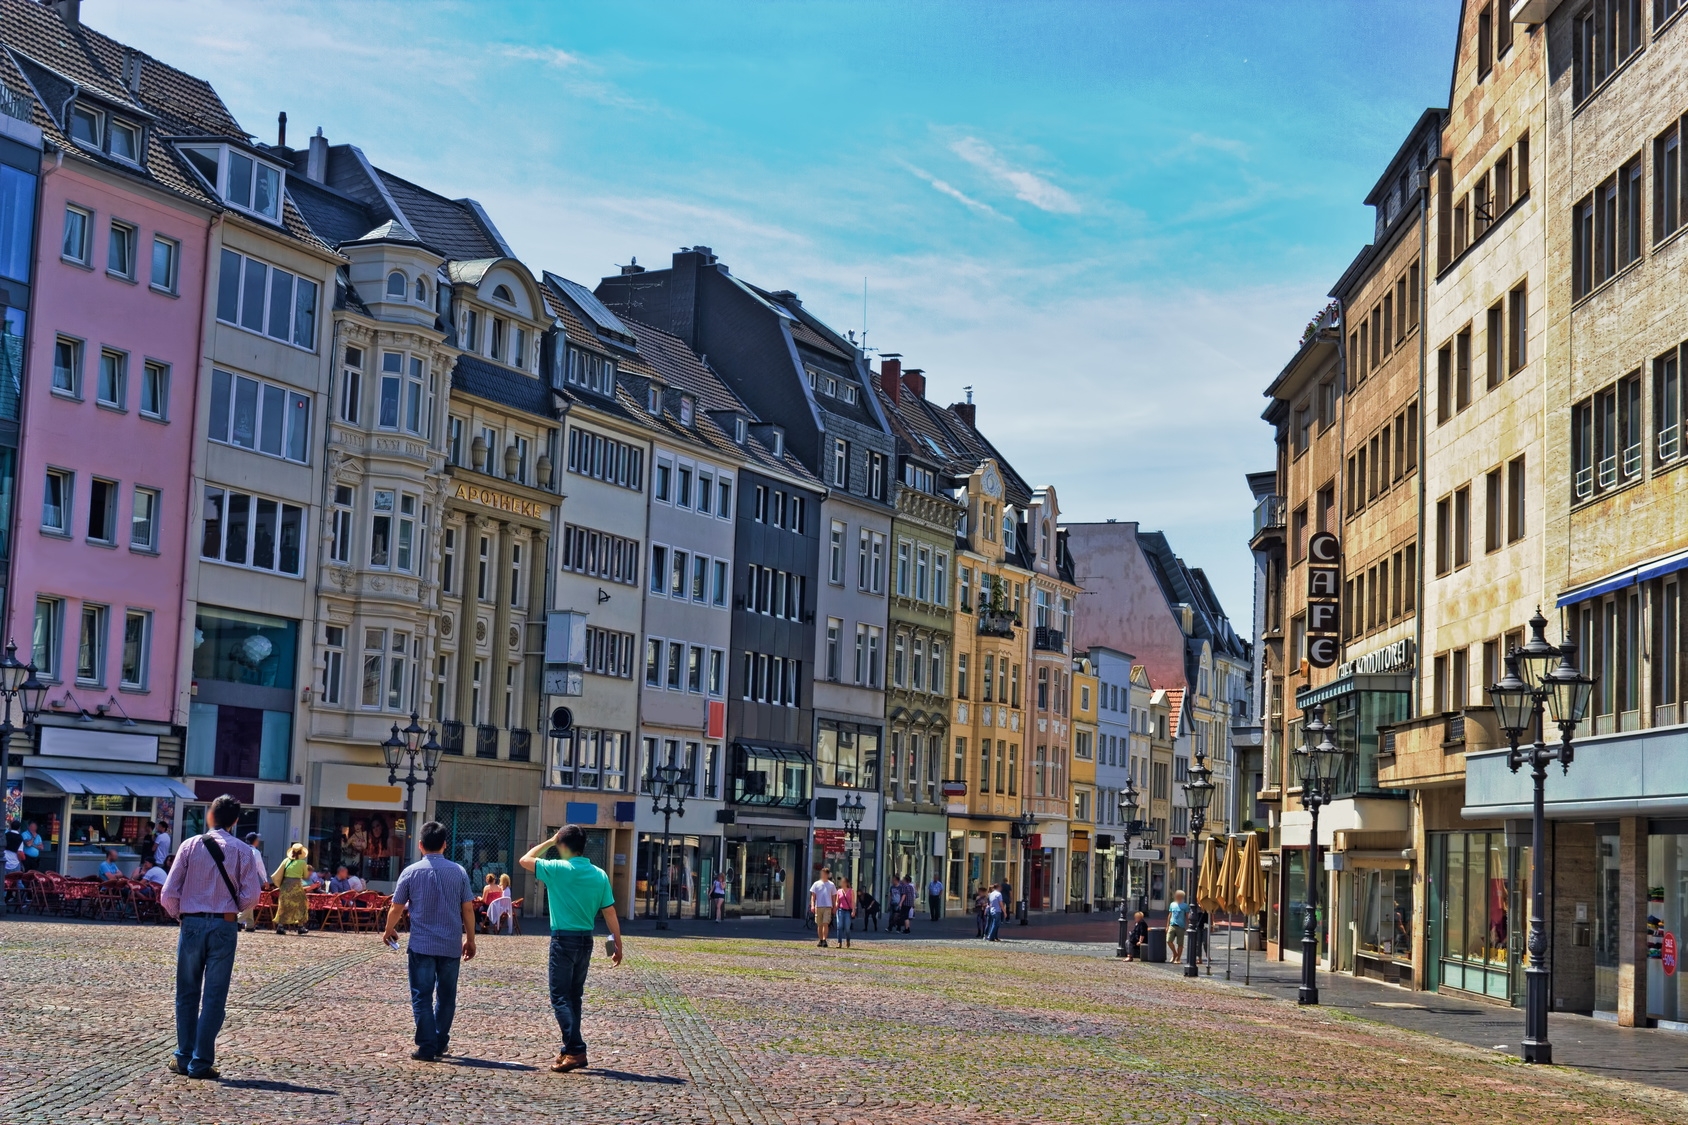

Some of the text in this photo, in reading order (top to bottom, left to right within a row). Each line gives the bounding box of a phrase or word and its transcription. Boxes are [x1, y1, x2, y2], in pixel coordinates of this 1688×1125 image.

[455, 484, 542, 518] APOTHEKE
[1311, 536, 1334, 663] CAFE
[1356, 640, 1407, 673] KONDITOREI
[1665, 938, 1673, 948] SALE
